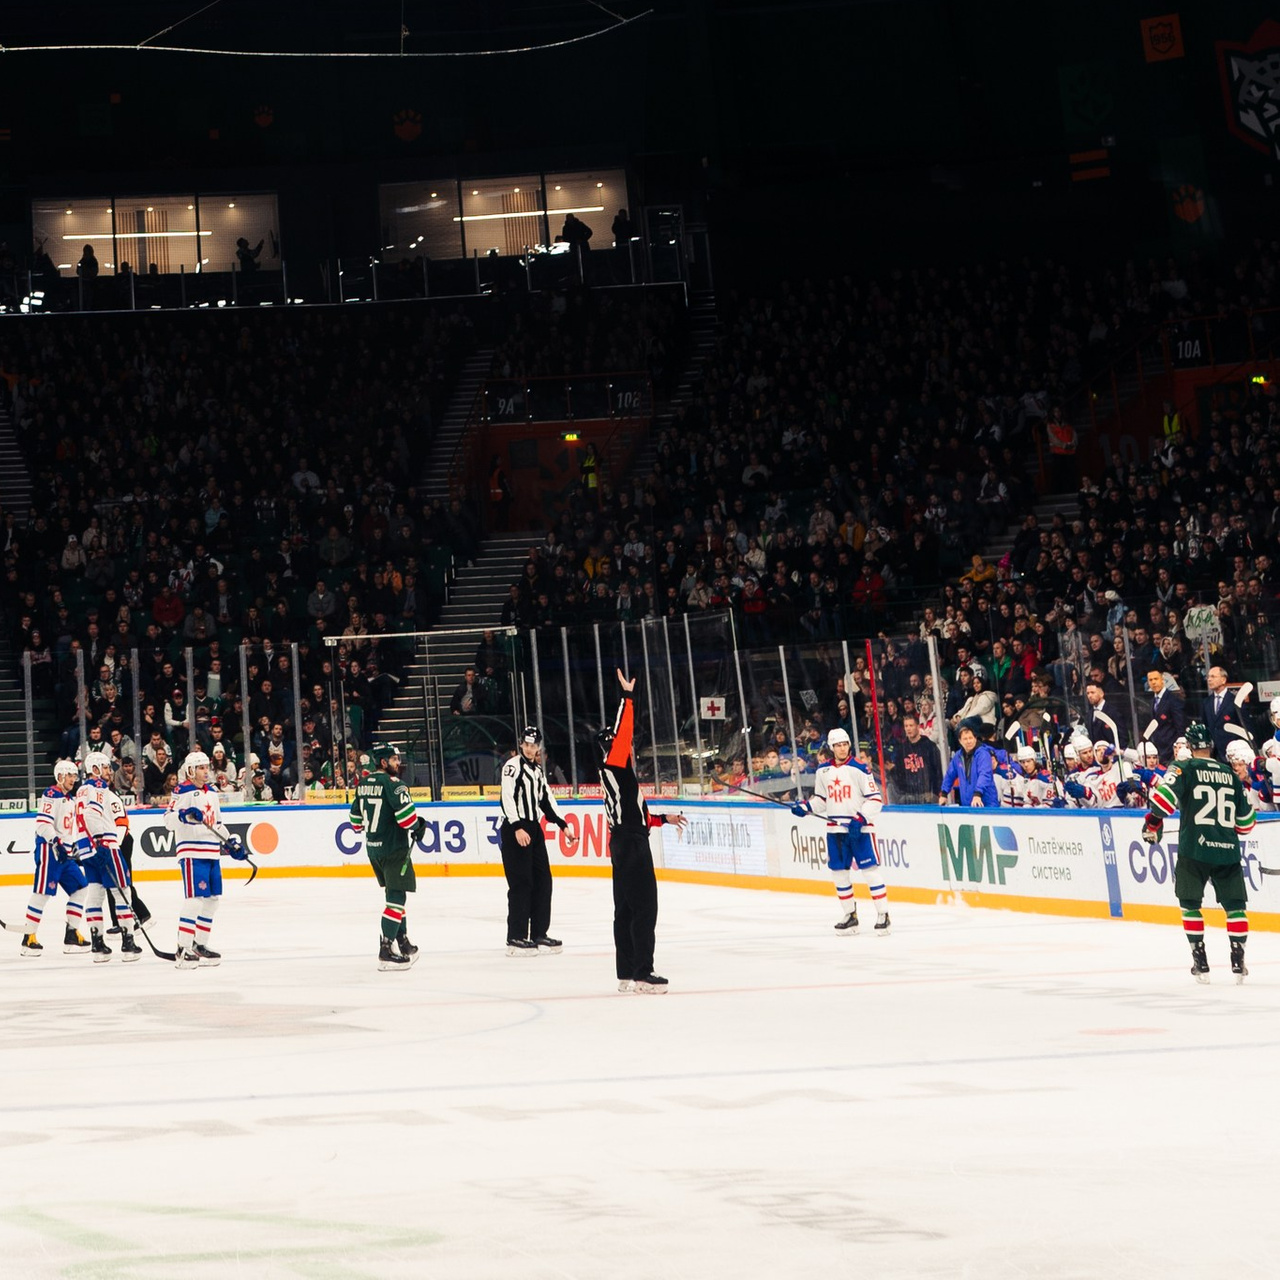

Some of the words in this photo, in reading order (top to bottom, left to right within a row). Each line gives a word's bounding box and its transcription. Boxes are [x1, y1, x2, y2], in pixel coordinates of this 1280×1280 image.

[1177, 340, 1201, 359] 10A
[498, 398, 515, 415] 9A
[1196, 769, 1234, 786] VOYNOV
[827, 785, 852, 803] СКА
[360, 798, 383, 832] 47
[1193, 785, 1236, 828] 26
[791, 826, 827, 870] Янде
[937, 824, 1018, 885] МИР
[1028, 836, 1084, 856] Платёжная
[1205, 841, 1236, 850] TATNEFT
[1032, 865, 1071, 881] система
